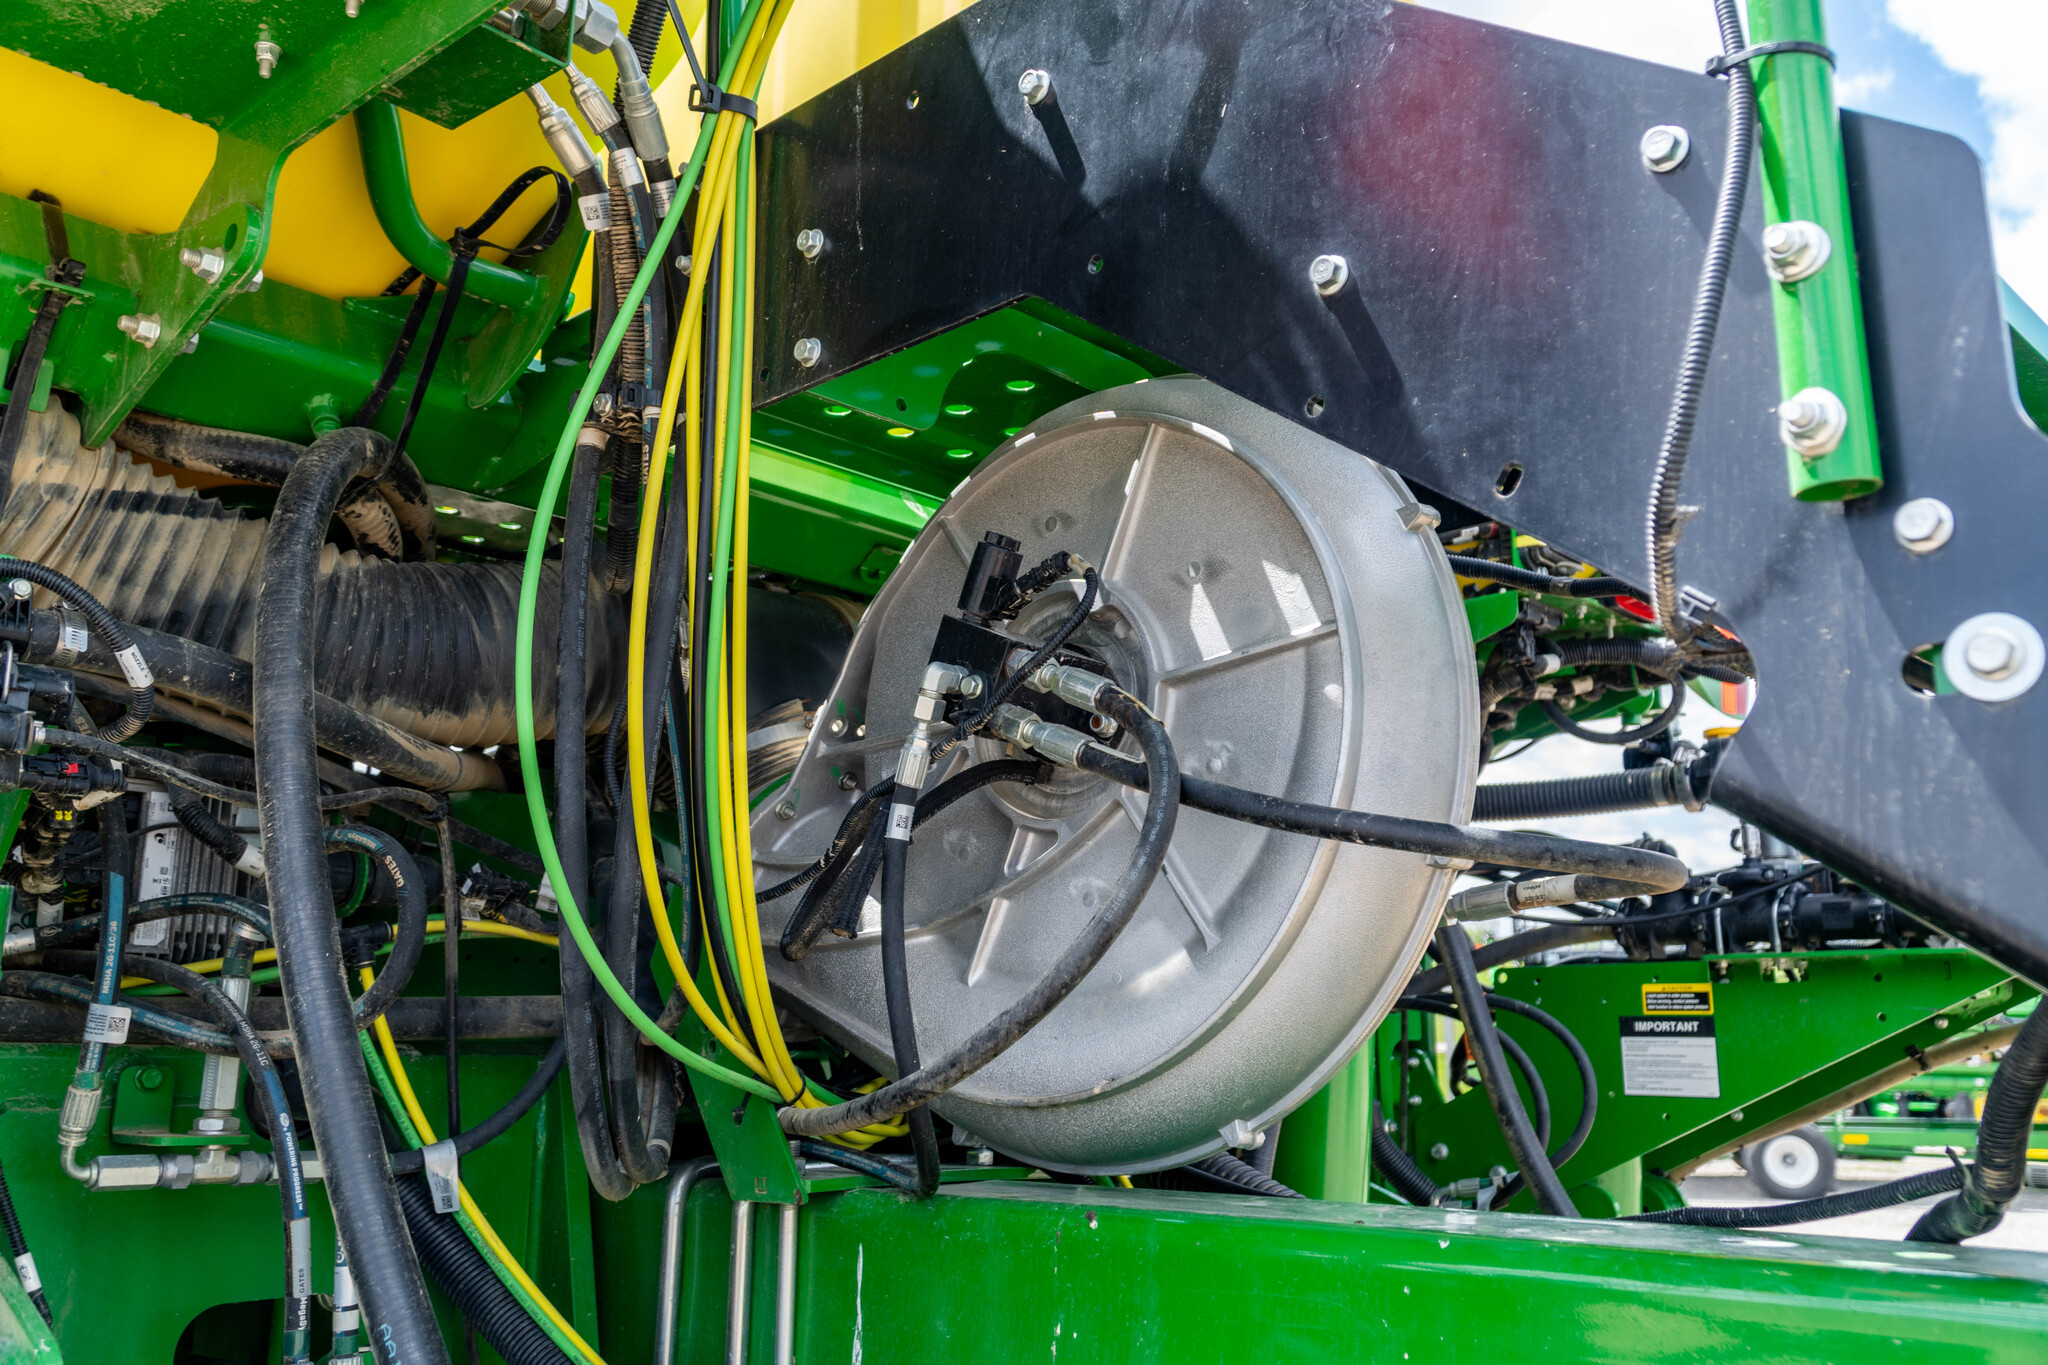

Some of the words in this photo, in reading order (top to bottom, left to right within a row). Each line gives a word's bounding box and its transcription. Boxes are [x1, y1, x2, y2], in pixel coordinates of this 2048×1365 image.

[642, 444, 650, 485] GATES
[384, 855, 405, 888] GATES
[102, 968, 112, 994] MSHA
[240, 1021, 255, 1040] MSHA
[250, 1039, 269, 1066] 2G-11C
[1634, 1021, 1699, 1032] IMPORTANT
[285, 1132, 297, 1167] POWERING
